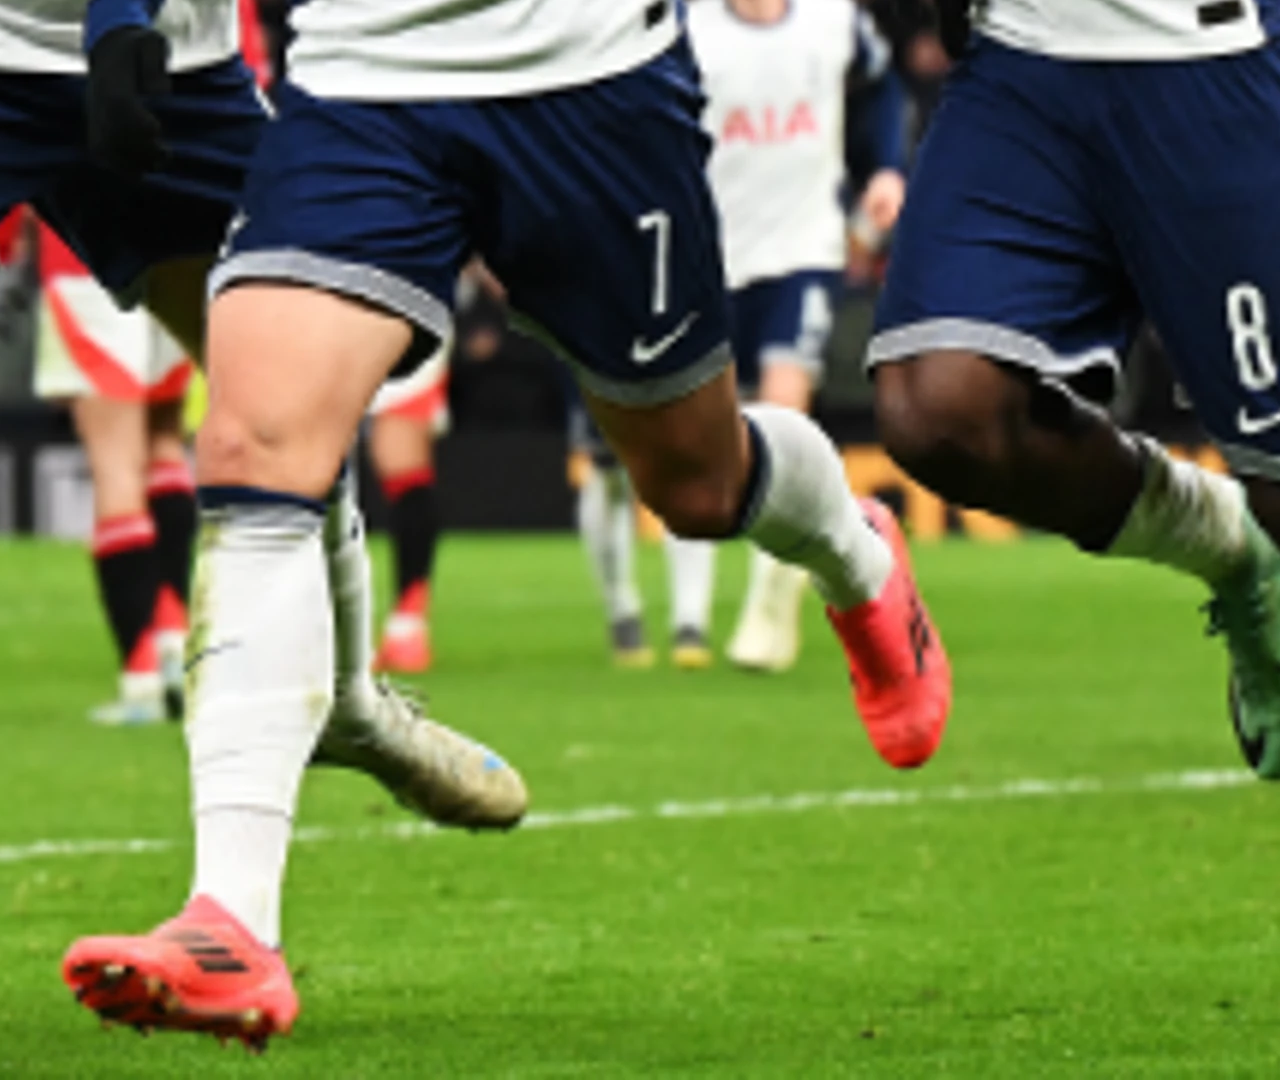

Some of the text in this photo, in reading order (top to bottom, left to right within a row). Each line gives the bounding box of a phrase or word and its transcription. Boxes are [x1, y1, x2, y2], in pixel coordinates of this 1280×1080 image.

[721, 99, 818, 144] AIA
[636, 210, 670, 314] 7
[1226, 283, 1278, 392] 8
